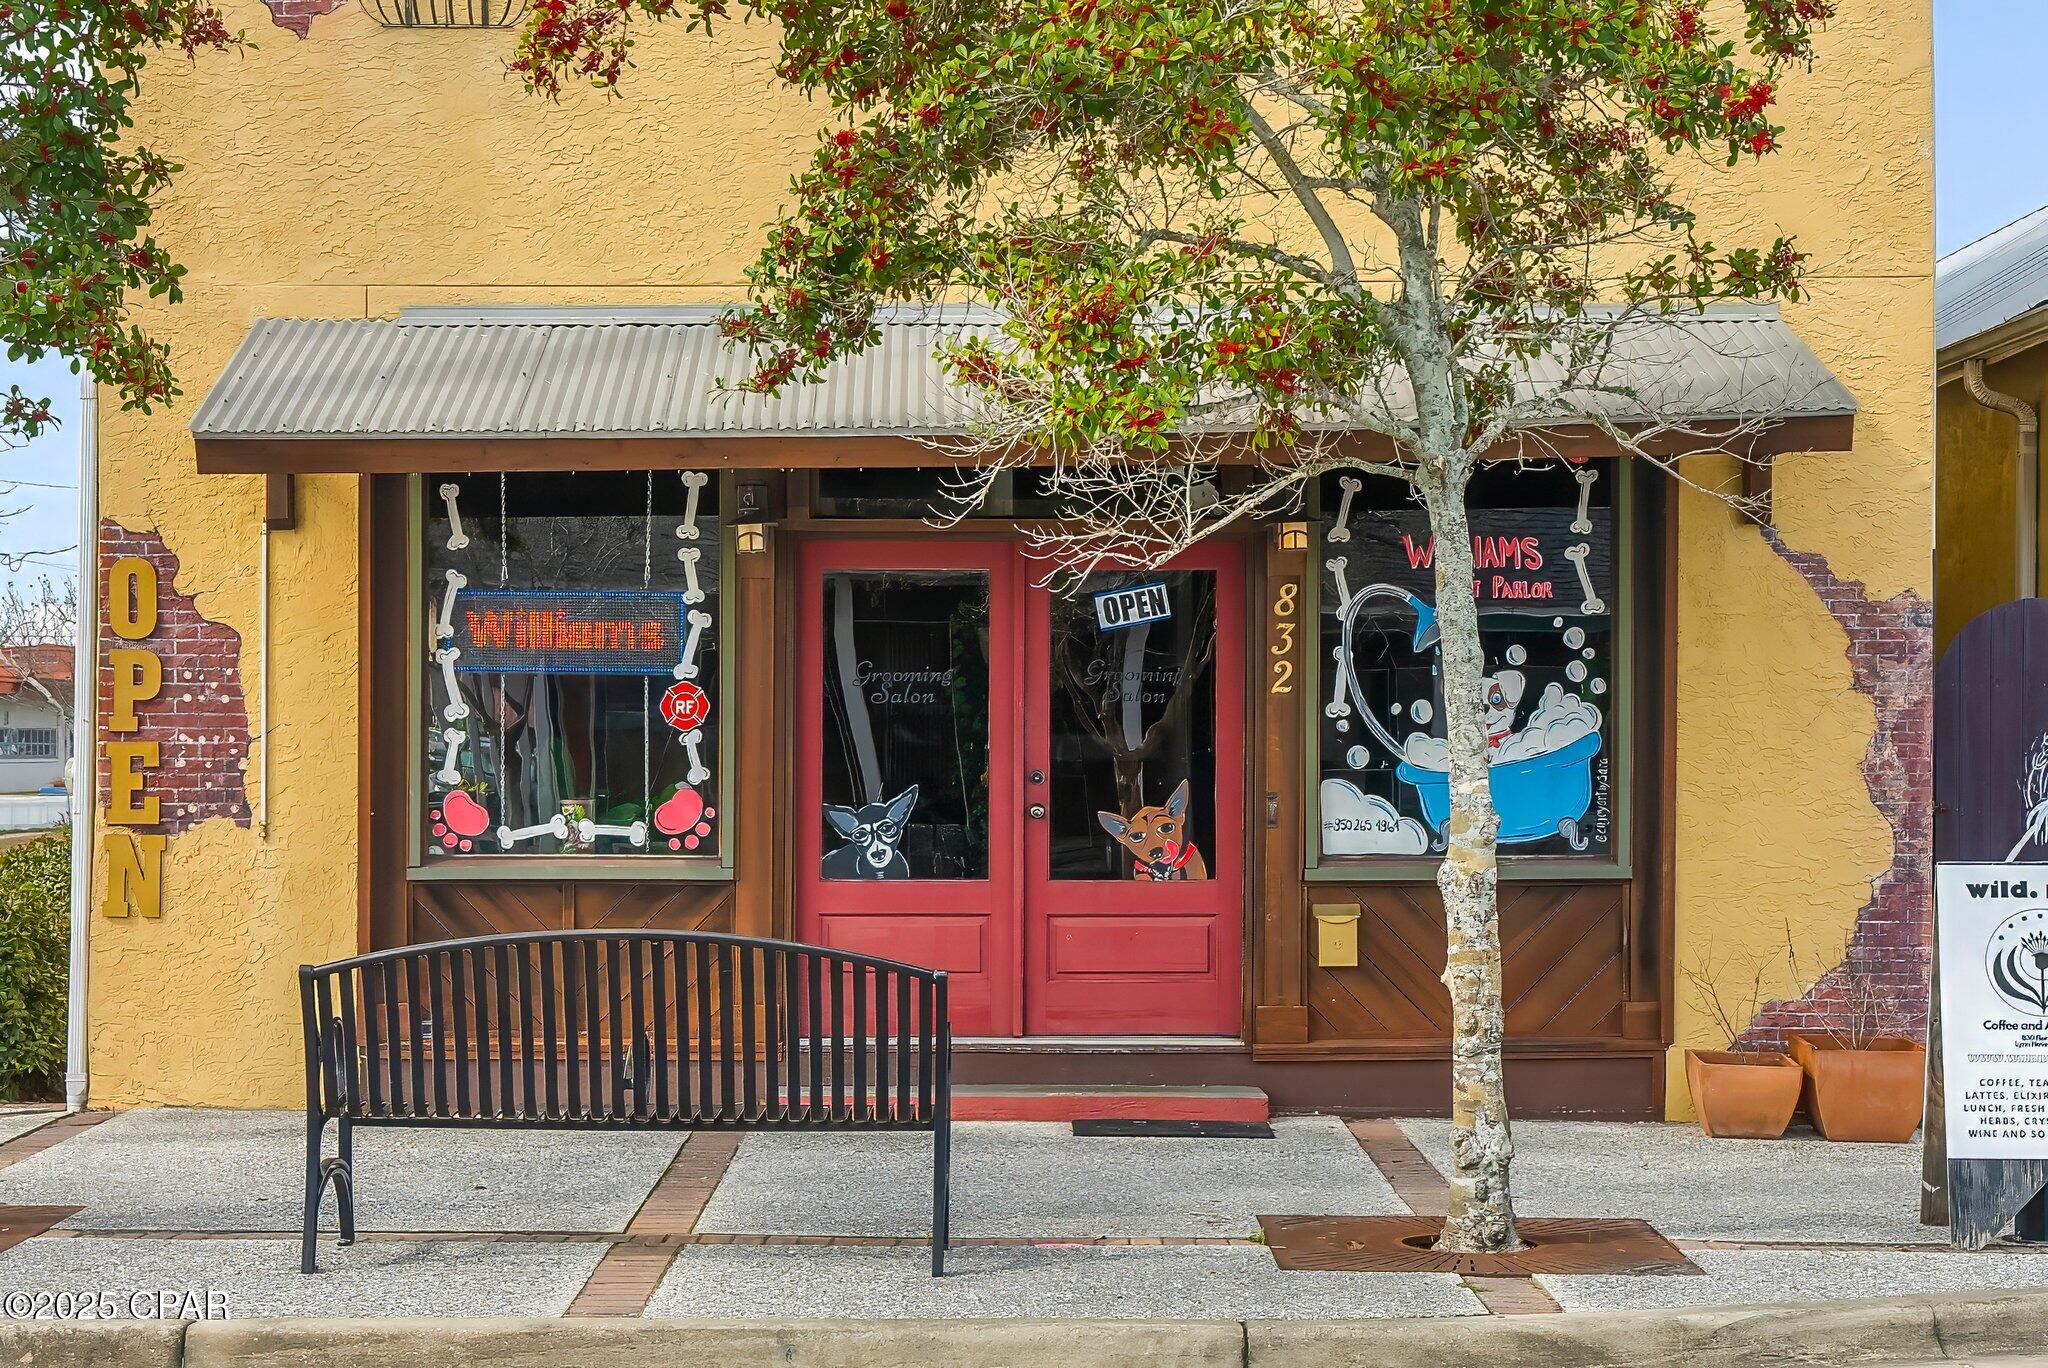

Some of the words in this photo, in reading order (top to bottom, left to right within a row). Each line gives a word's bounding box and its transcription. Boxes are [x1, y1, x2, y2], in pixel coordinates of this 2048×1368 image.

[1402, 533, 1543, 571] WIAMS
[1102, 586, 1168, 625] OPEN
[465, 607, 666, 651] Williams
[1270, 583, 1298, 694] 832
[853, 660, 954, 687] Grooming
[871, 681, 935, 704] Salon
[1102, 681, 1166, 703] Salon
[673, 700, 693, 715] RF
[102, 557, 167, 918] OPEN
[1966, 880, 2038, 899] wild.
[1983, 1019, 2019, 1031] Coffee
[2021, 1019, 2043, 1031] and
[1979, 1078, 2024, 1088] COFFEE,
[1965, 1091, 2009, 1100] LATTES,
[1963, 1104, 2006, 1113] LUNCH,
[2011, 1104, 2045, 1113] FRESH
[1968, 1129, 1998, 1138] WINE
[2002, 1129, 2026, 1138] AND
